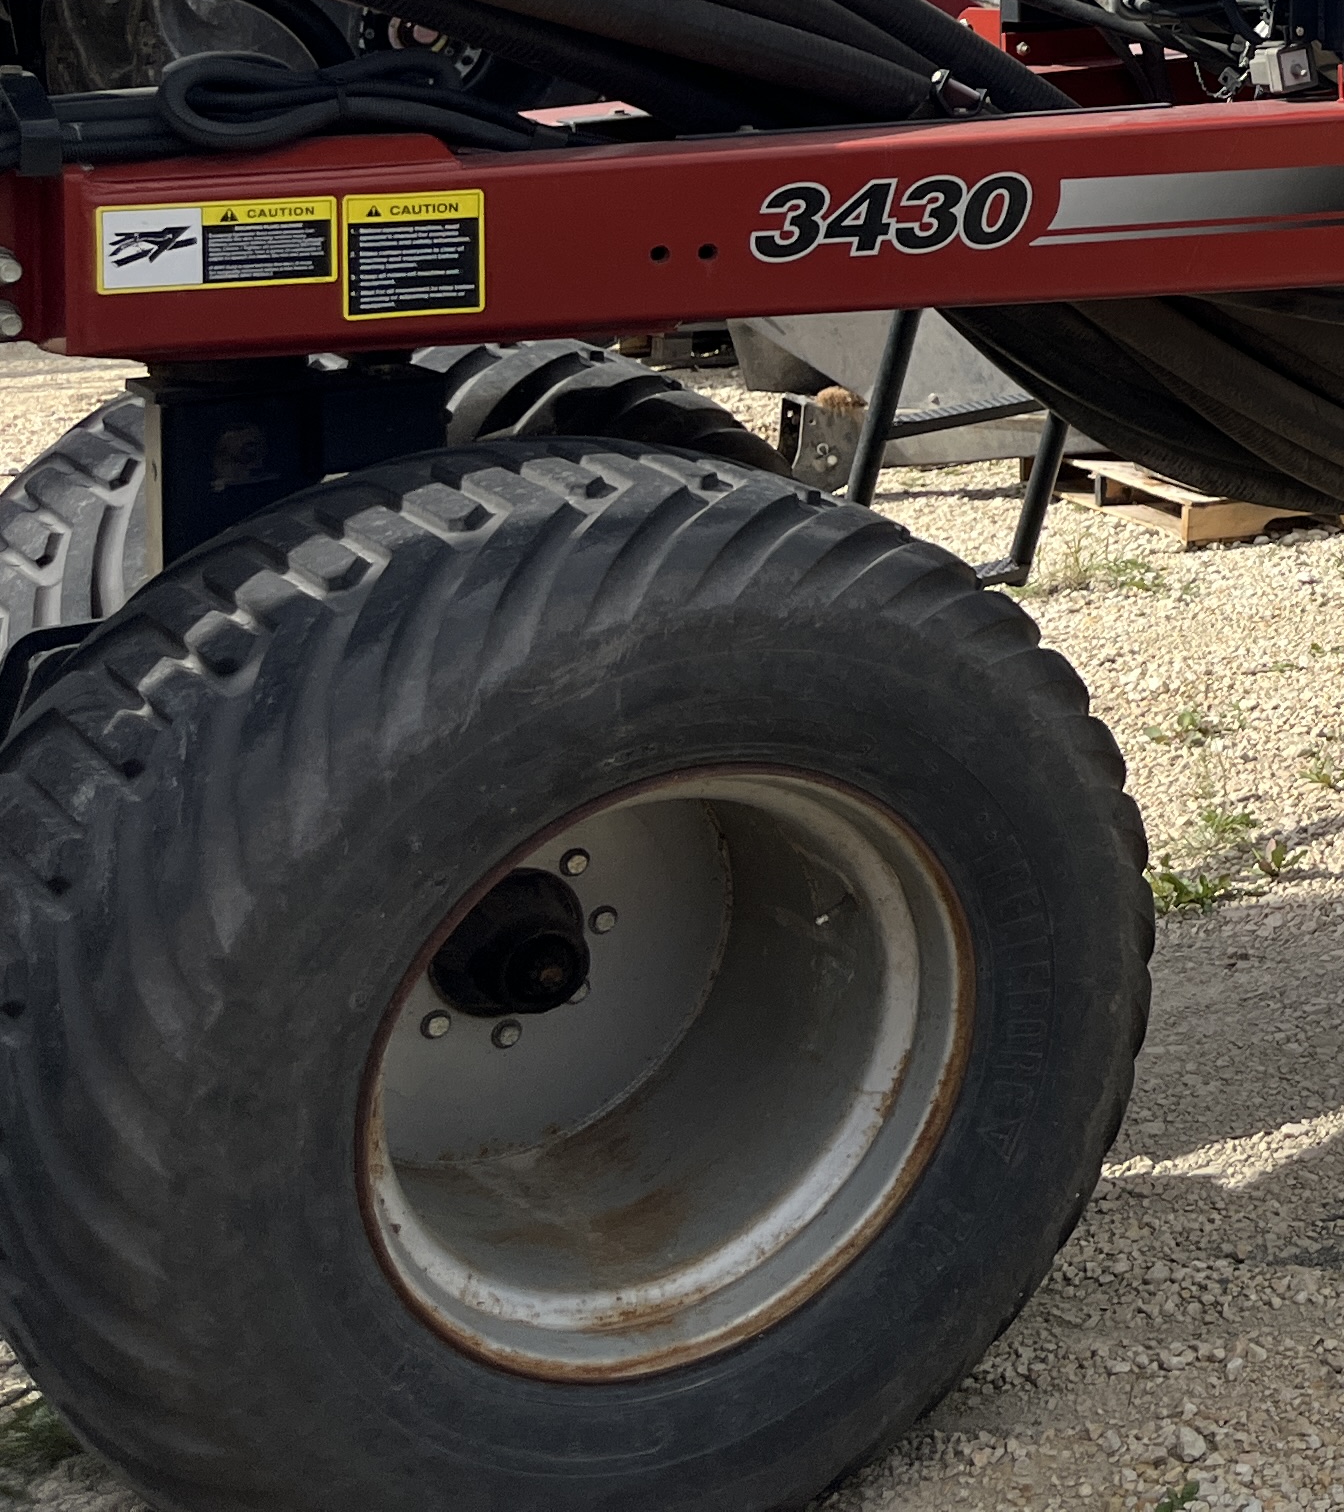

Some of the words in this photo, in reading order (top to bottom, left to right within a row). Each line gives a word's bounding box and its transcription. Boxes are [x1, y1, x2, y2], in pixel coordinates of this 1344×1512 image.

[246, 205, 316, 220] CAUTION
[389, 202, 460, 216] CAUTION
[749, 170, 1034, 265] 3430
